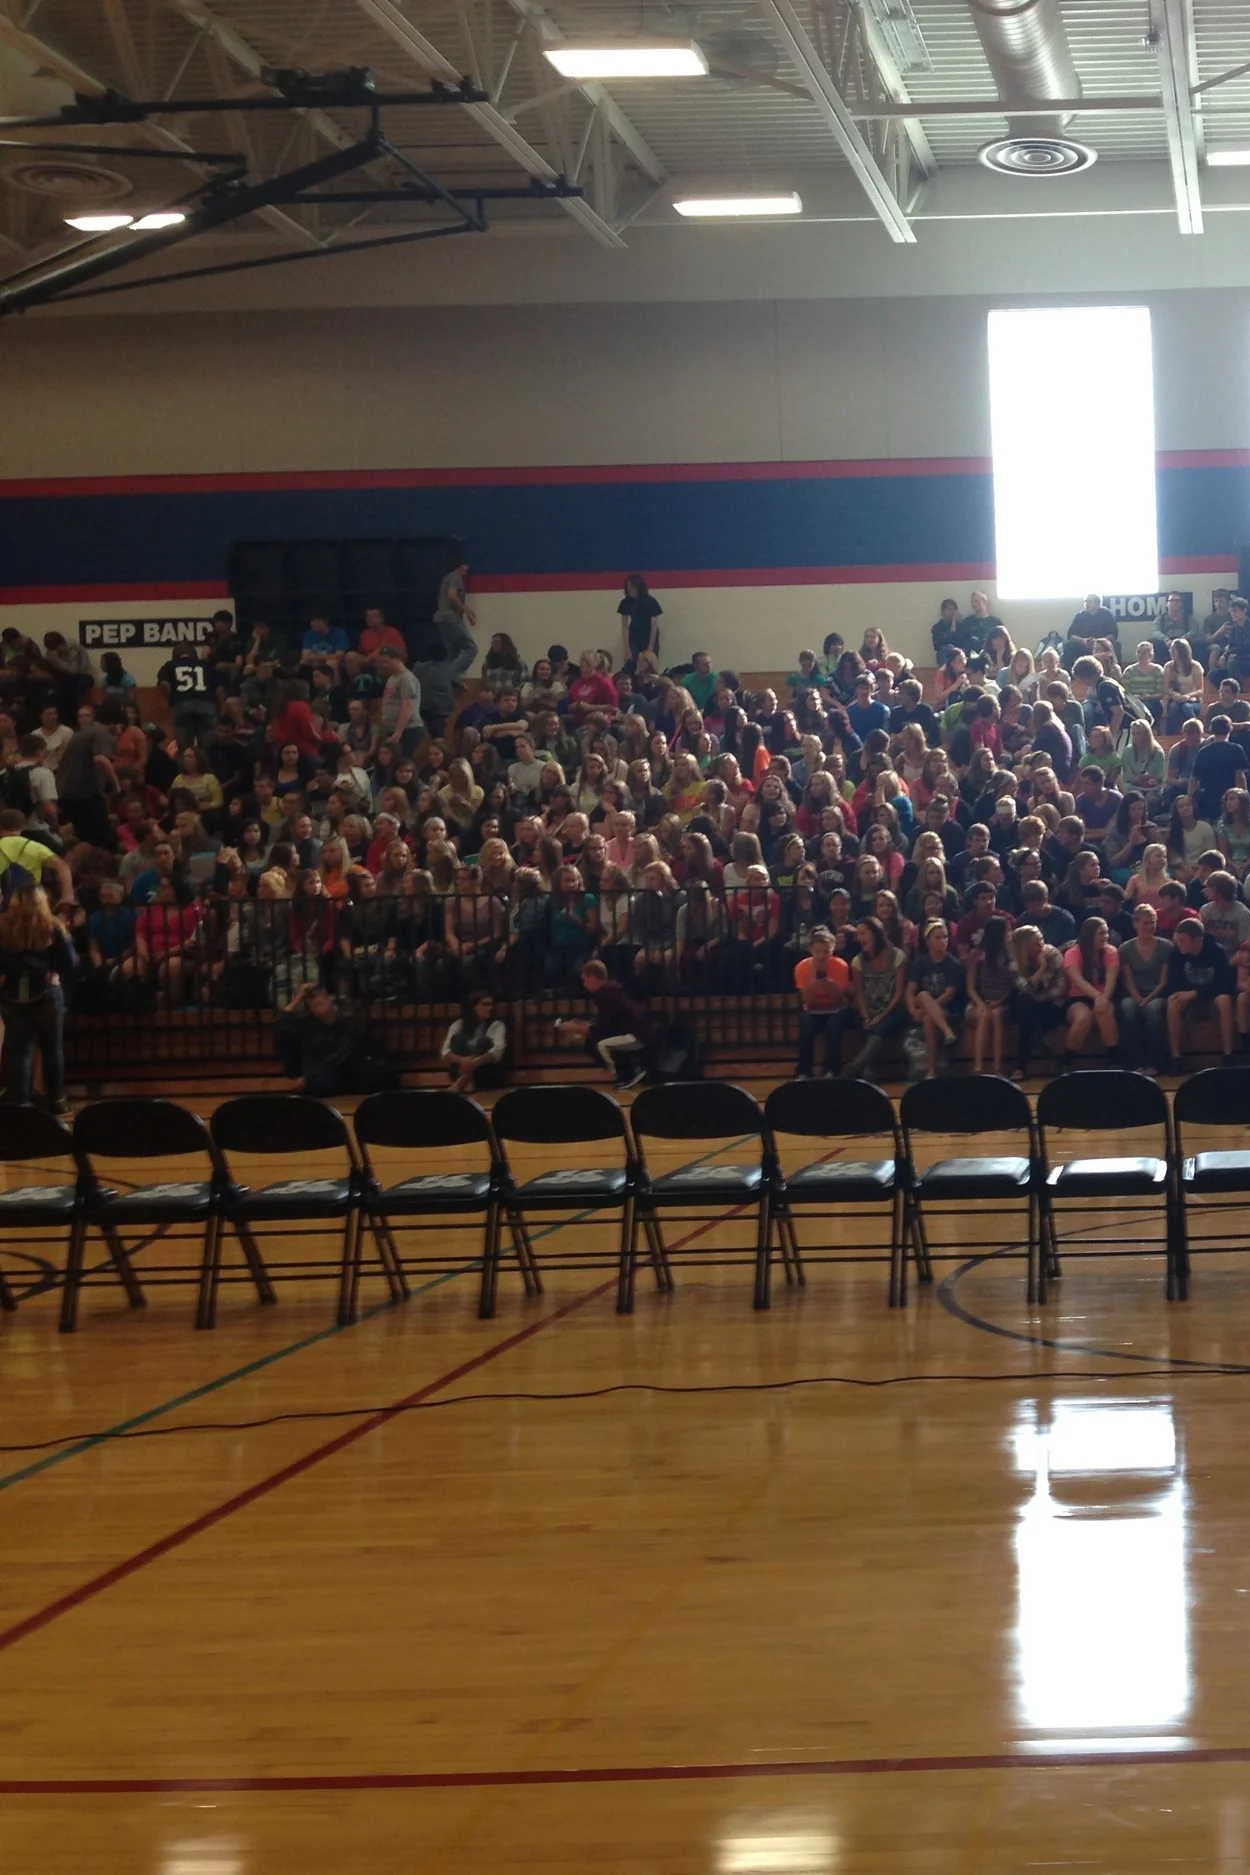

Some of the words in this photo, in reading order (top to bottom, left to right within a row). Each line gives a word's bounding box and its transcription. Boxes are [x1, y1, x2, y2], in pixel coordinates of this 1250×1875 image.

[1109, 596, 1168, 617] HOM
[85, 623, 136, 645] PEP
[175, 666, 207, 692] 51
